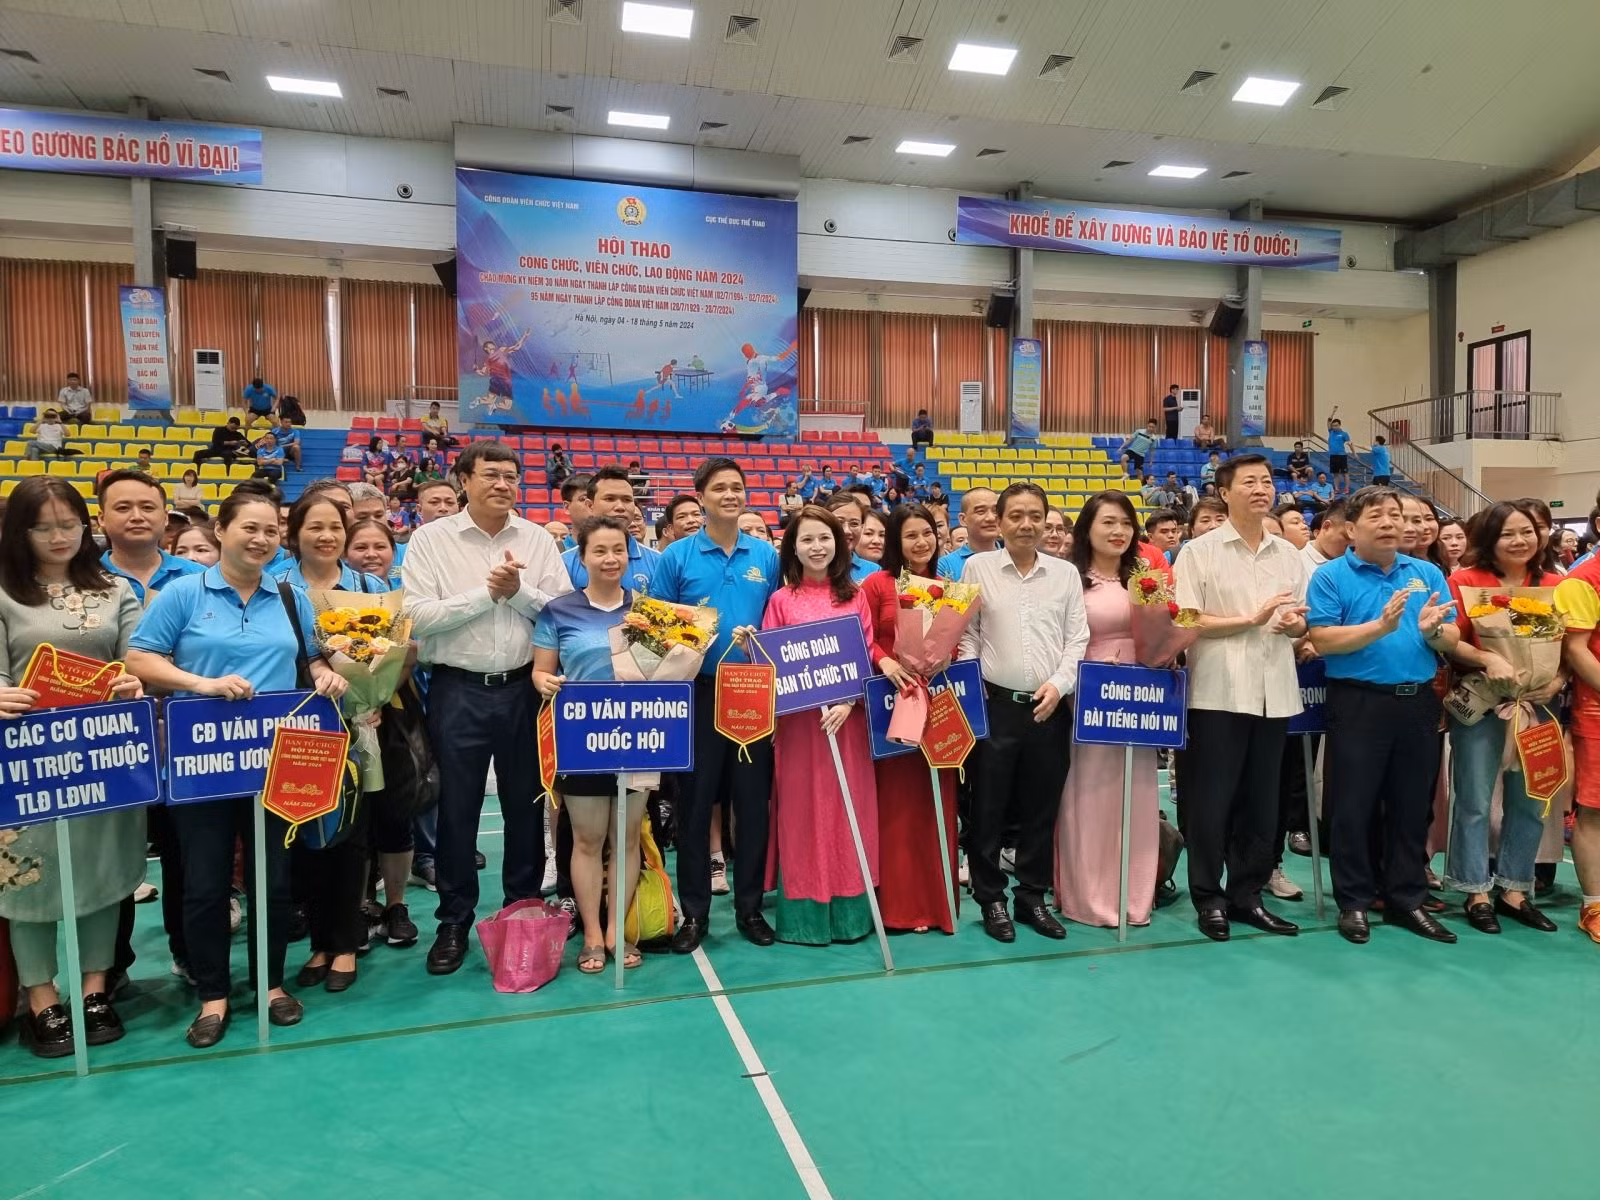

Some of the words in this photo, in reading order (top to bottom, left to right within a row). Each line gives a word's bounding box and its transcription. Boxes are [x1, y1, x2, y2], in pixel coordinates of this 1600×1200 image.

[33, 130, 96, 160] GƯƠNG
[102, 134, 140, 162] BÁC
[146, 134, 170, 166] HỒ
[176, 139, 194, 167] VĨ
[1009, 210, 1050, 237] KHOẺ
[1054, 211, 1074, 239] ĐỂ
[1078, 217, 1108, 241] XÂY
[1156, 224, 1174, 247] VÀ
[1179, 226, 1208, 250] BẢO
[1211, 228, 1229, 255] VỆ
[1232, 228, 1251, 253] TỔ
[1253, 231, 1290, 257] QUỐC
[598, 236, 625, 258] HỘI
[630, 241, 671, 259] THAO
[551, 258, 582, 273] CHỨC,
[585, 261, 609, 274] VIÊN
[612, 262, 642, 278] CHỨC,
[645, 266, 662, 278] LAO
[666, 267, 692, 282] ĐỘNG
[696, 270, 718, 283] NĂM
[721, 273, 744, 285] 2024
[530, 292, 538, 301] 95
[655, 301, 669, 311] NAM
[545, 278, 553, 287] 30
[700, 289, 713, 299] NAM
[574, 314, 584, 322] Hà
[639, 318, 658, 328] tháng
[780, 640, 810, 663] CÔNG
[810, 634, 840, 657] ĐOÀN
[776, 674, 799, 696] BAN
[797, 664, 812, 690] TỔ
[814, 665, 842, 689] CHỨC
[841, 662, 858, 680] TW
[1100, 680, 1131, 702] CÔNG
[1134, 683, 1164, 704] ĐOÀN
[563, 702, 587, 720] CĐ
[592, 698, 626, 720] VĂN
[631, 697, 688, 719] PHÒNG
[1084, 706, 1103, 727] ĐÀI
[1106, 707, 1138, 729] TIẾNG
[1141, 710, 1160, 731] NÓI
[1163, 715, 1178, 732] VN
[4, 721, 45, 749] CÁC
[50, 717, 77, 743] CƠ
[82, 712, 139, 740] QUAN,
[192, 722, 216, 744] CĐ
[222, 716, 258, 741] VĂN
[586, 726, 632, 753] QUỐC
[637, 728, 665, 753] HỘI
[8, 760, 29, 786] VỊ
[33, 752, 84, 780] TRỰC
[88, 740, 149, 770] THUỘC
[174, 752, 235, 777] TRUNG
[240, 747, 272, 770] ƯƠN
[15, 790, 51, 816] TLĐ
[56, 782, 106, 810] LĐVN
